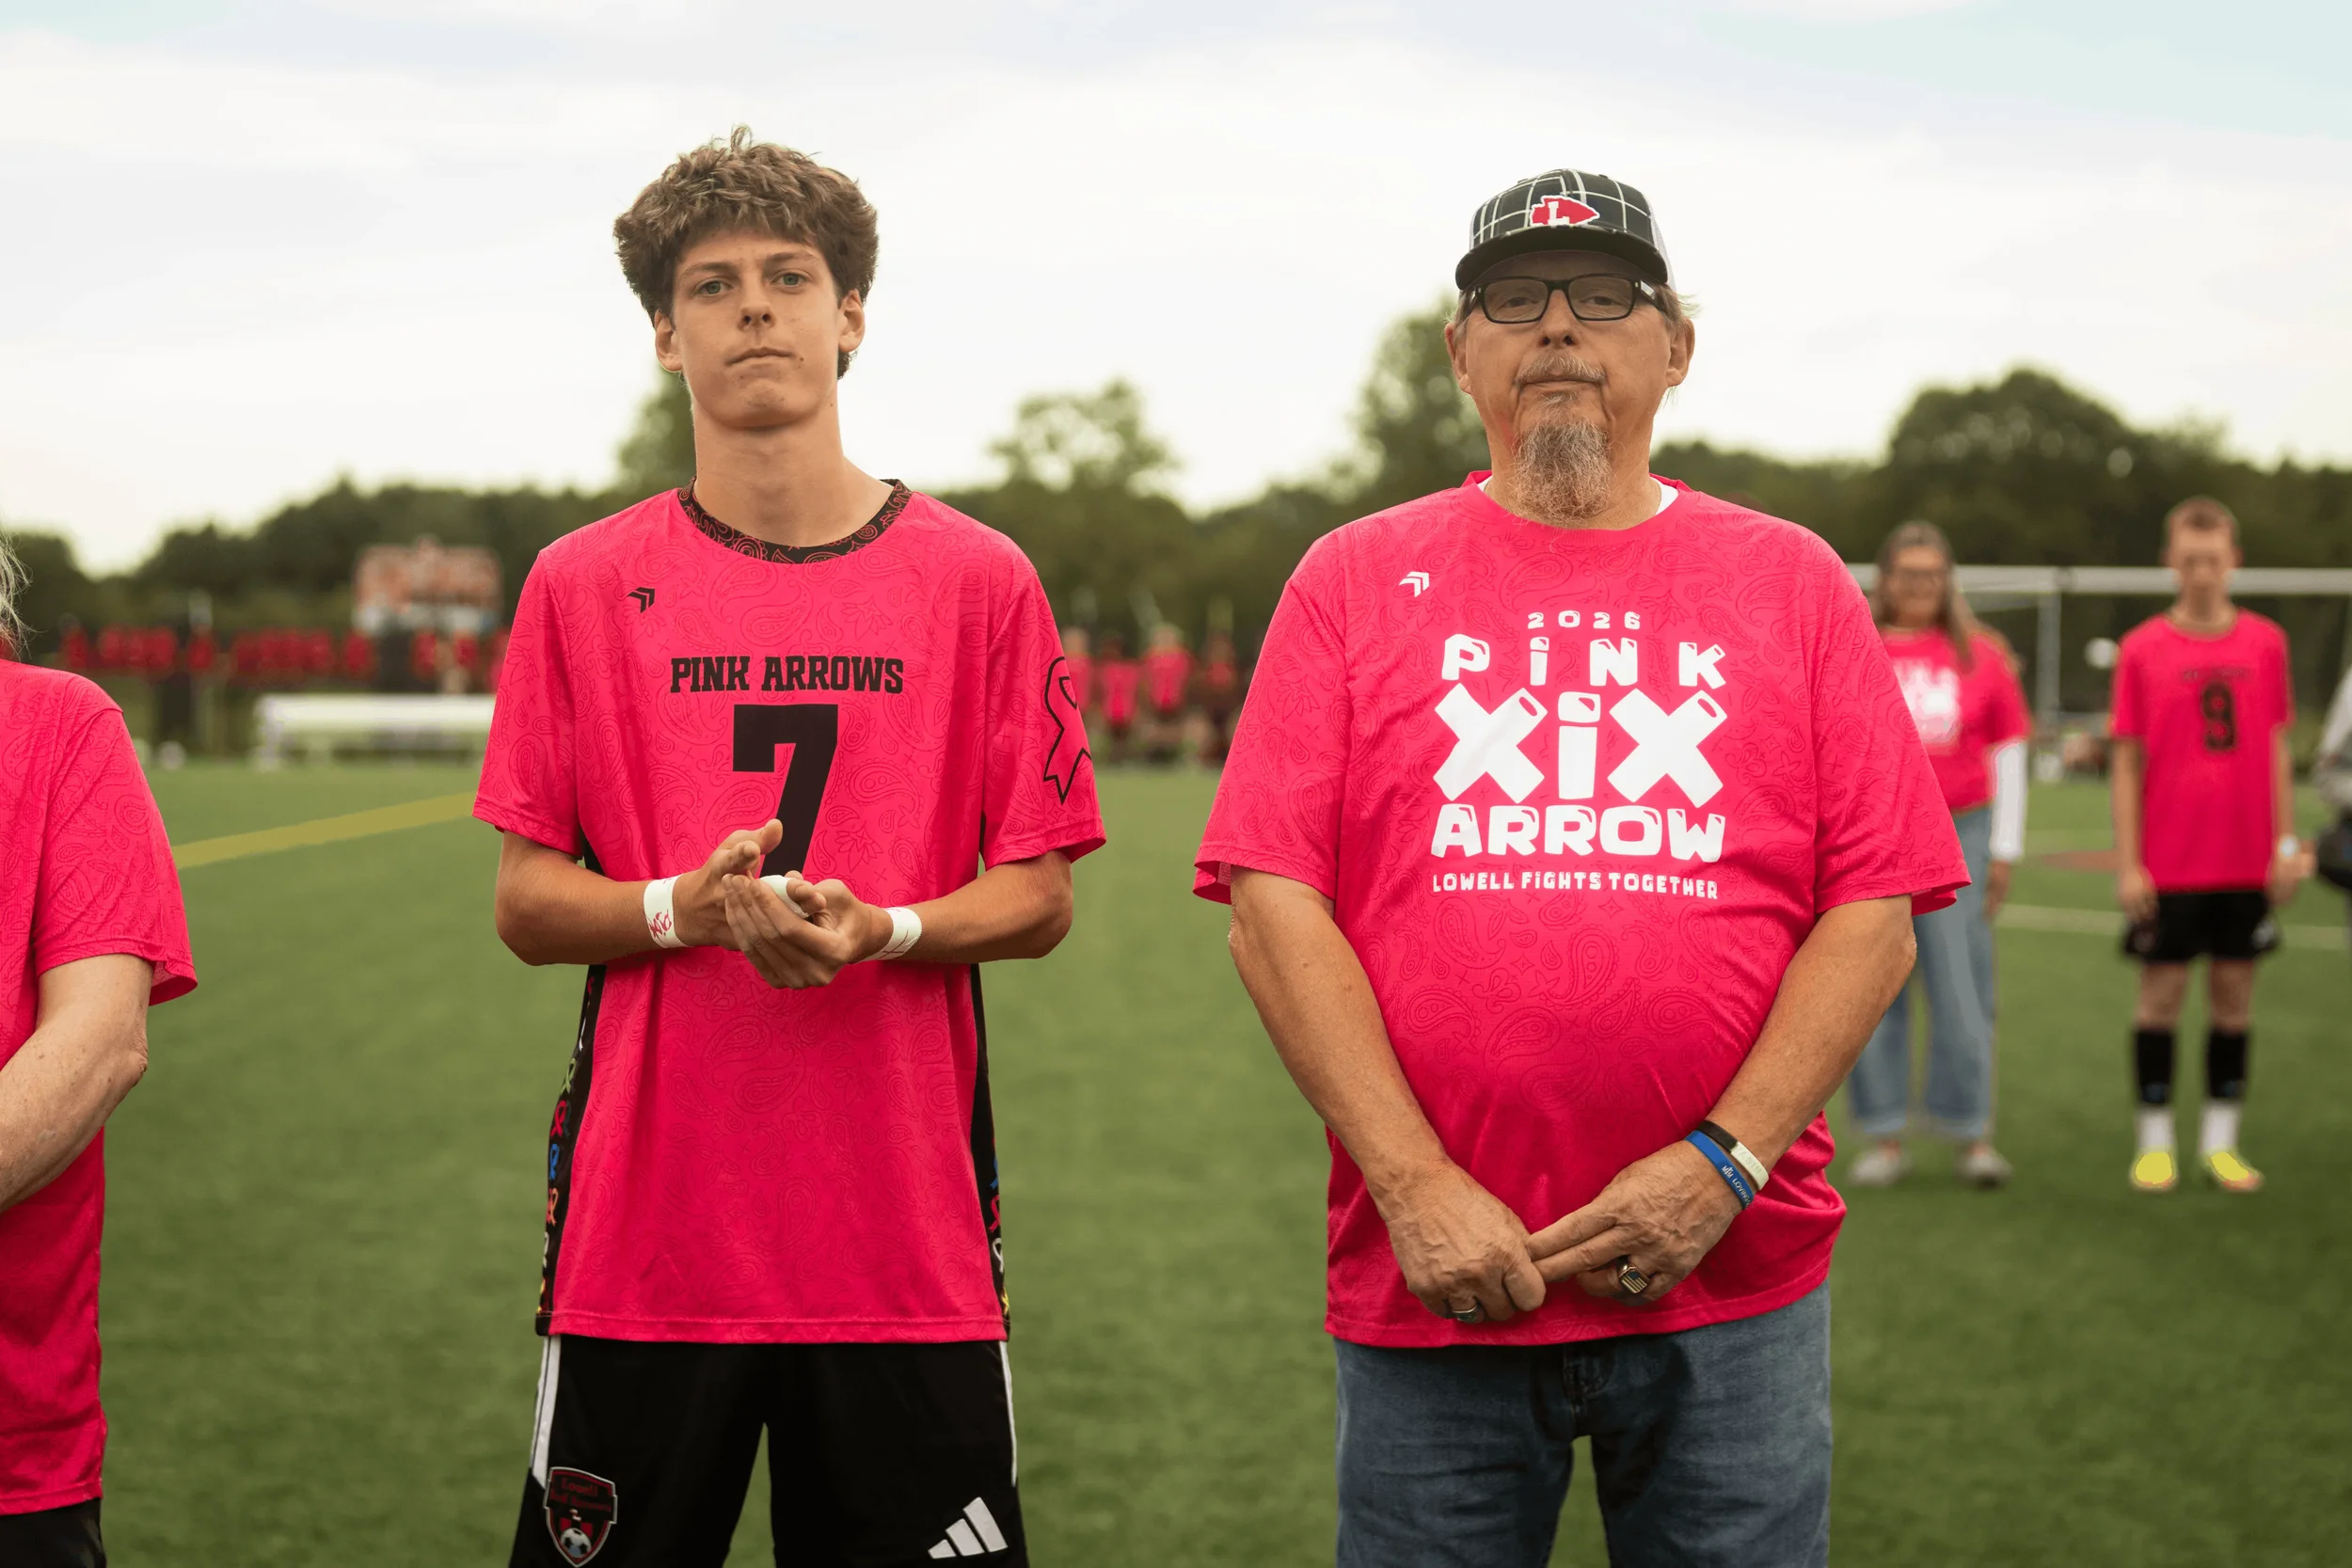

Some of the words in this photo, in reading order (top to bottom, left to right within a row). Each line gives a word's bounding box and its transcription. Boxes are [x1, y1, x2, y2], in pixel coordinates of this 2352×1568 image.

[1548, 200, 1570, 226] L
[1527, 610, 1641, 630] 2026
[670, 656, 751, 694] PINK
[760, 655, 904, 694] ARROWS
[2201, 680, 2237, 752] 9
[732, 703, 839, 879] 7
[1430, 803, 1726, 863] ARROW
[1432, 872, 1515, 893] LOWELL
[1608, 872, 1719, 900] TOGETHER
